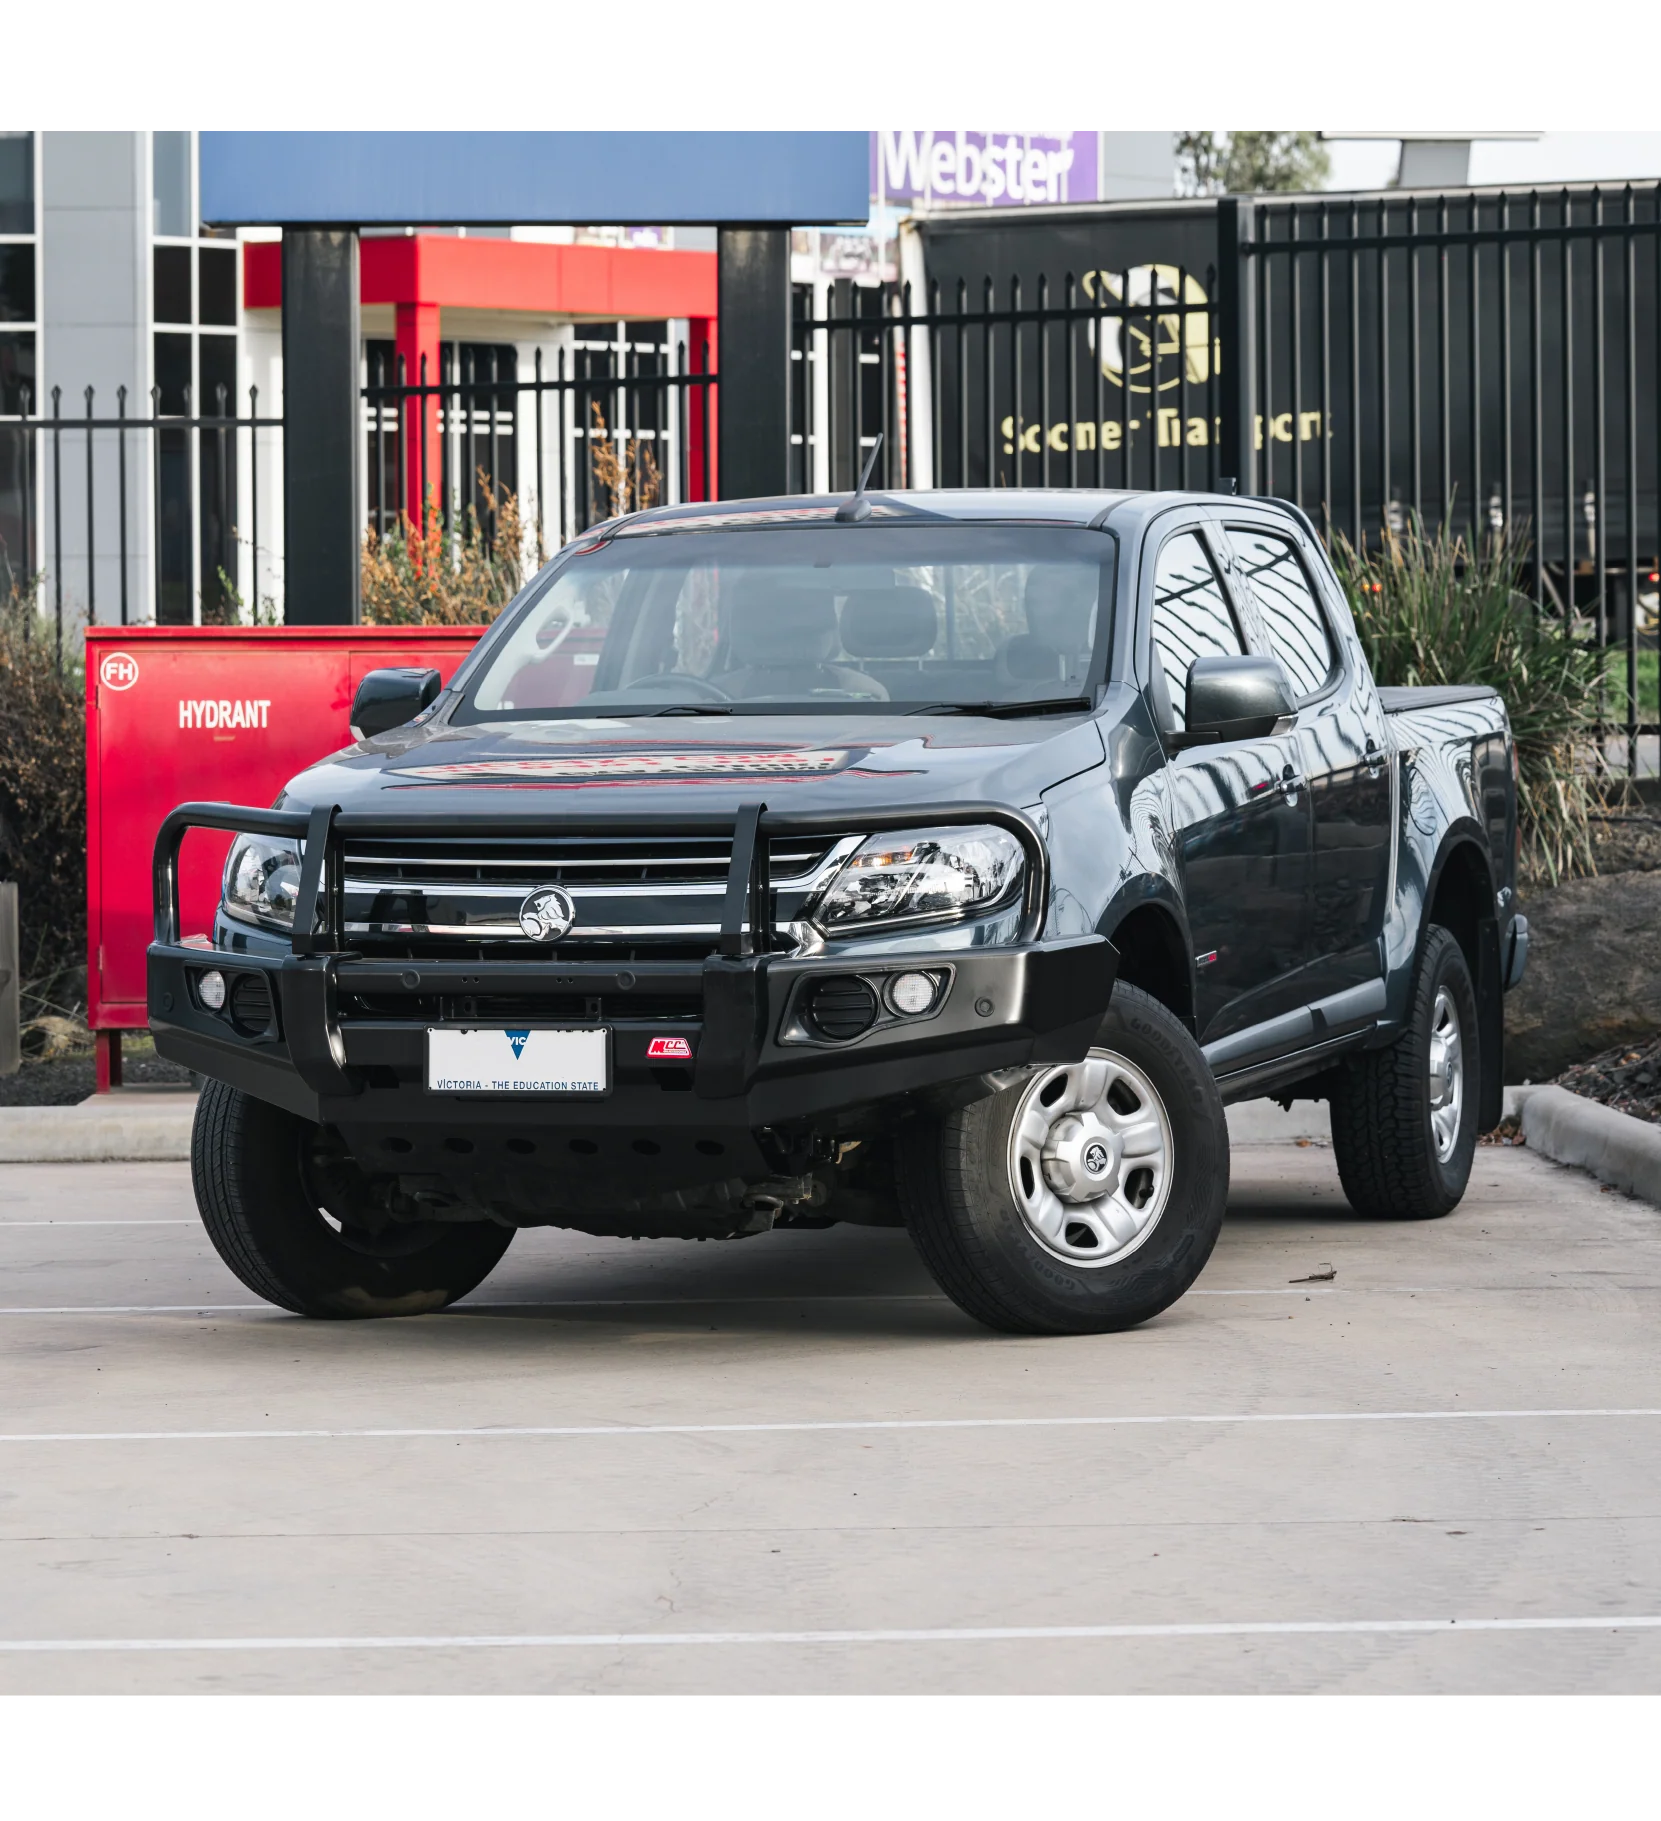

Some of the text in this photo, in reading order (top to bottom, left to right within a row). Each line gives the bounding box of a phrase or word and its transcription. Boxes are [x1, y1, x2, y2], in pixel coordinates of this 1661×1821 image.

[884, 129, 1075, 203] Webster
[105, 662, 134, 681] FH
[178, 699, 271, 729] HYDRANT
[506, 1036, 527, 1046] VIC
[437, 1078, 482, 1090] VICTORIA
[491, 1080, 510, 1090] THE
[513, 1081, 568, 1091] EDUCATION
[570, 1081, 599, 1091] STATE
